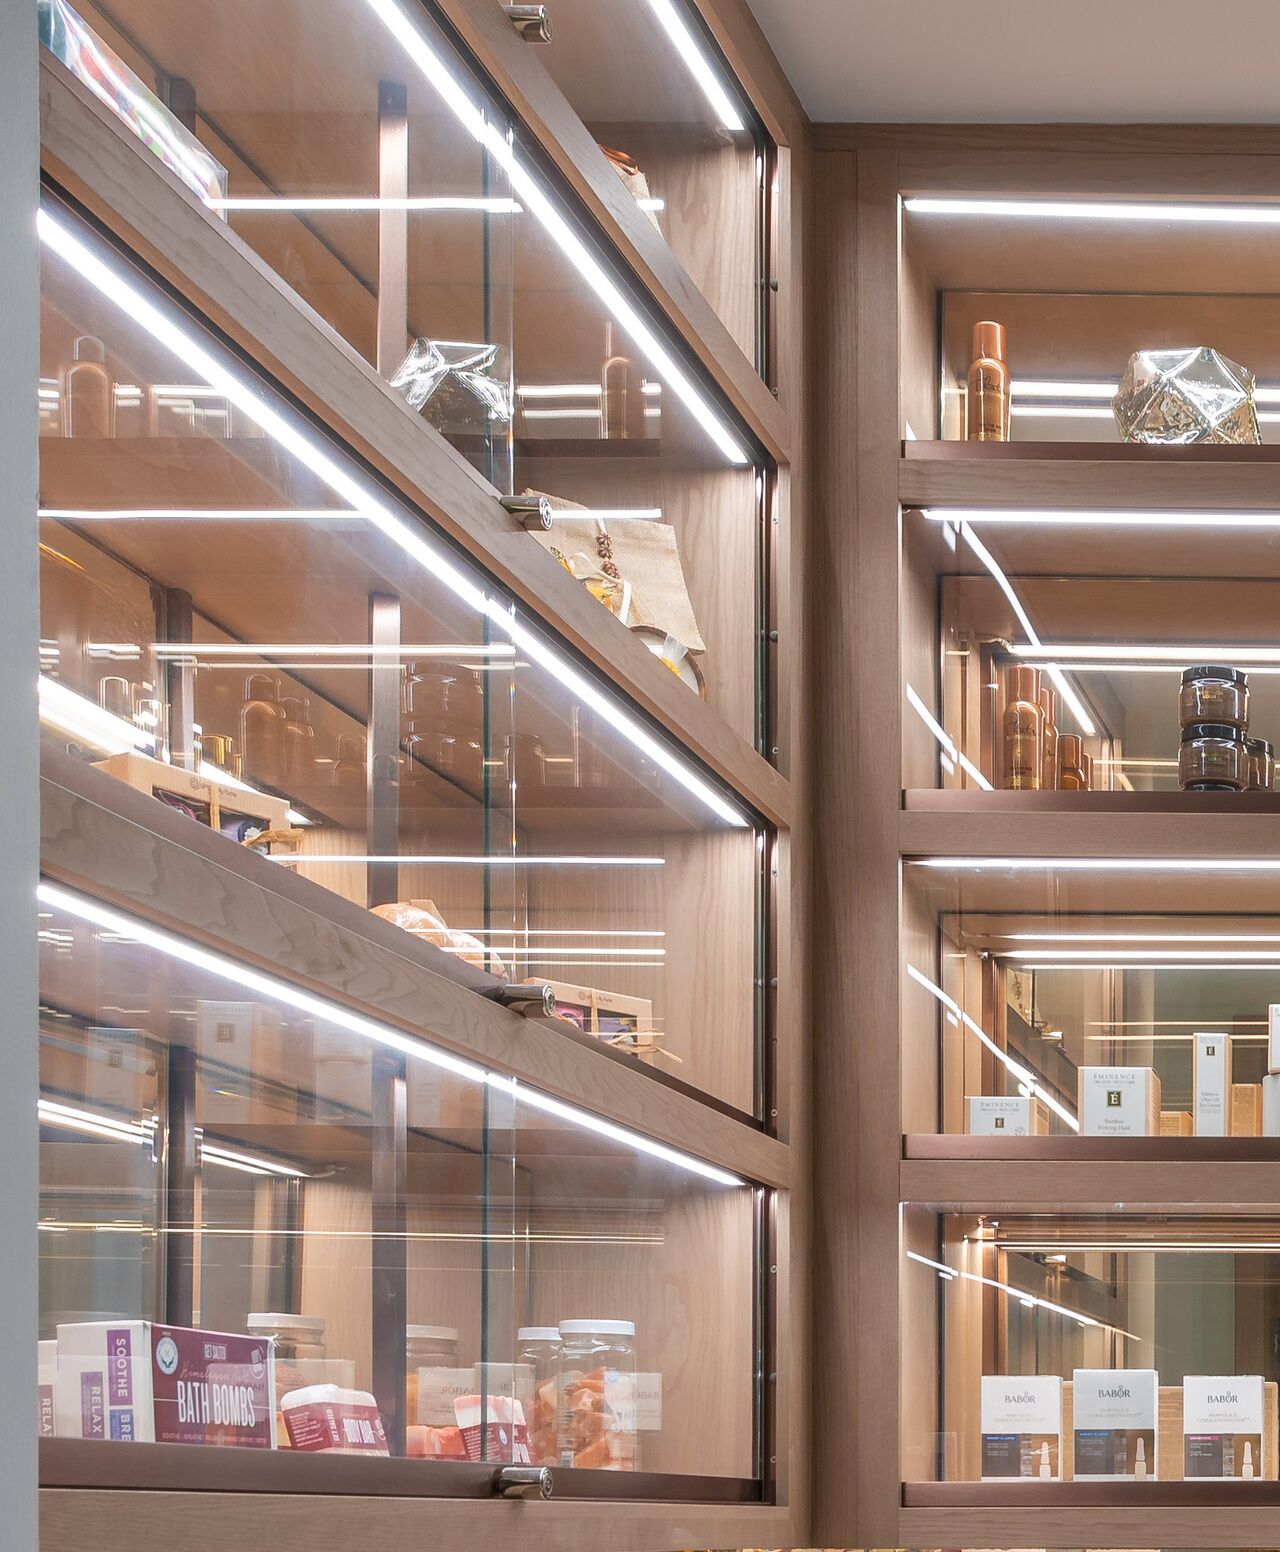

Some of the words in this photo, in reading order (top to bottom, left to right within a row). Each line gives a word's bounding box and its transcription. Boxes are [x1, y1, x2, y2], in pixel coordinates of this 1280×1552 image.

[115, 1337, 128, 1398] SOOTHE
[91, 1385, 103, 1433] RELAX
[177, 1380, 210, 1425] BATH
[212, 1384, 256, 1428] BOMBS
